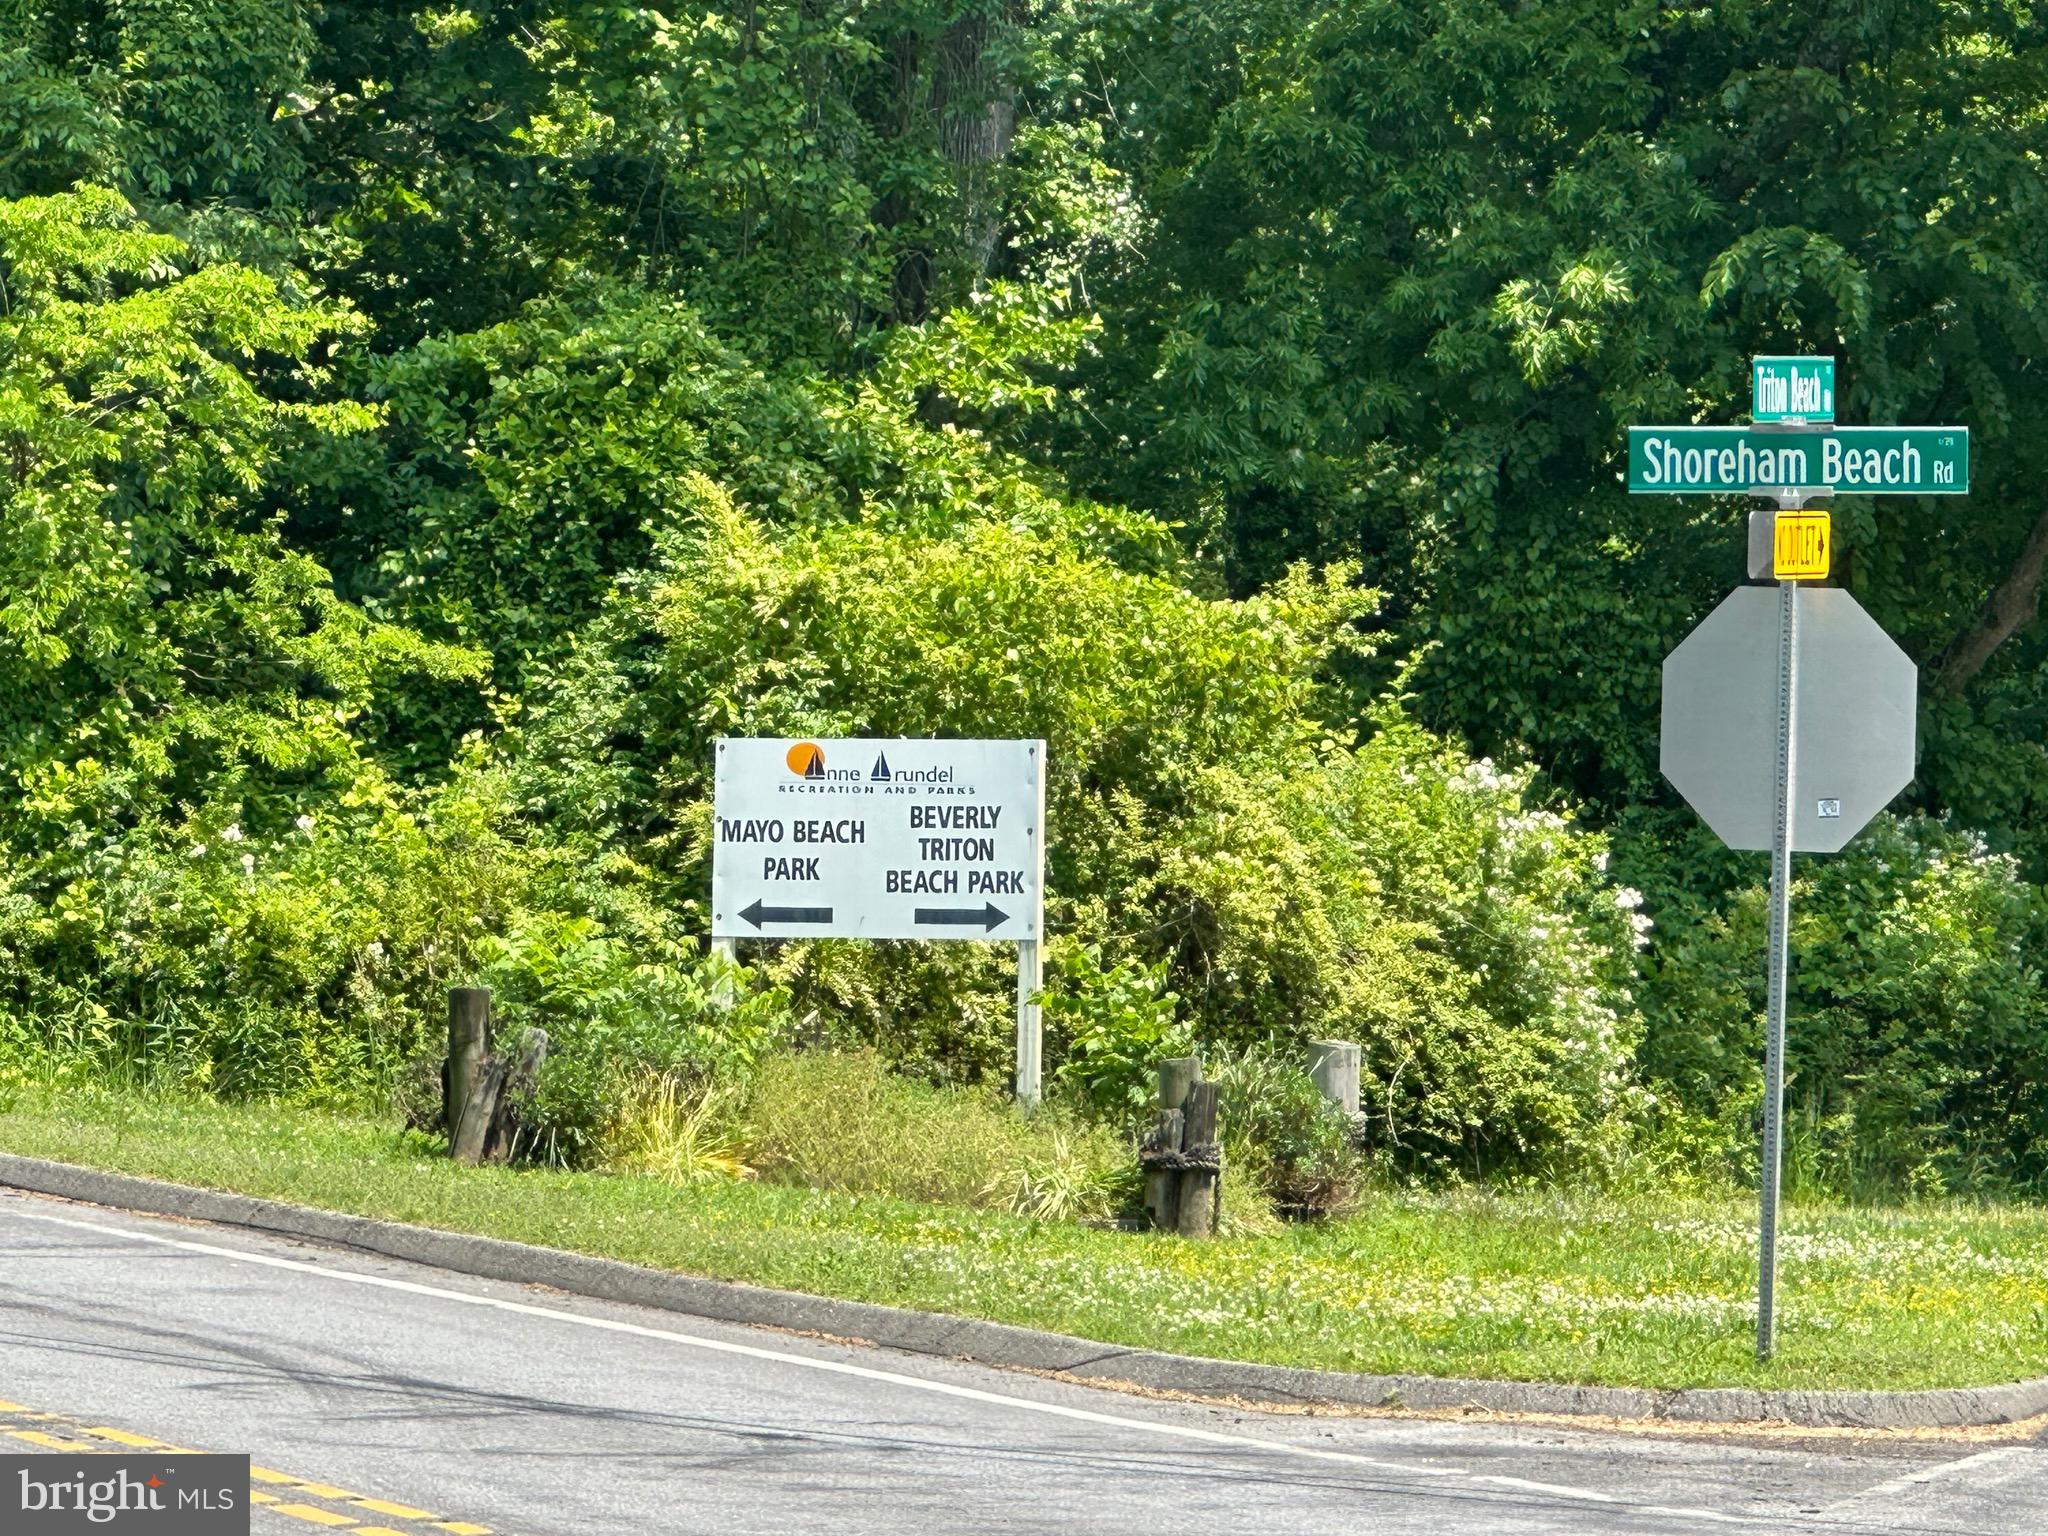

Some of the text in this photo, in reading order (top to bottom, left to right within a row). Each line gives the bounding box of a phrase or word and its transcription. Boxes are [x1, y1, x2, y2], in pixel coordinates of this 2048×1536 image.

[1757, 366, 1787, 413] Triton
[1791, 366, 1821, 413] Beach
[1643, 438, 1954, 484] Shoreham Beach Rd
[778, 785, 976, 795] RECREATION AND PARKS
[910, 805, 1001, 829] BEVERLY
[721, 820, 865, 843] MAYO BEACH
[918, 838, 994, 861] TRITON
[764, 857, 820, 880] PARK
[886, 870, 1025, 894] BEACH PARK
